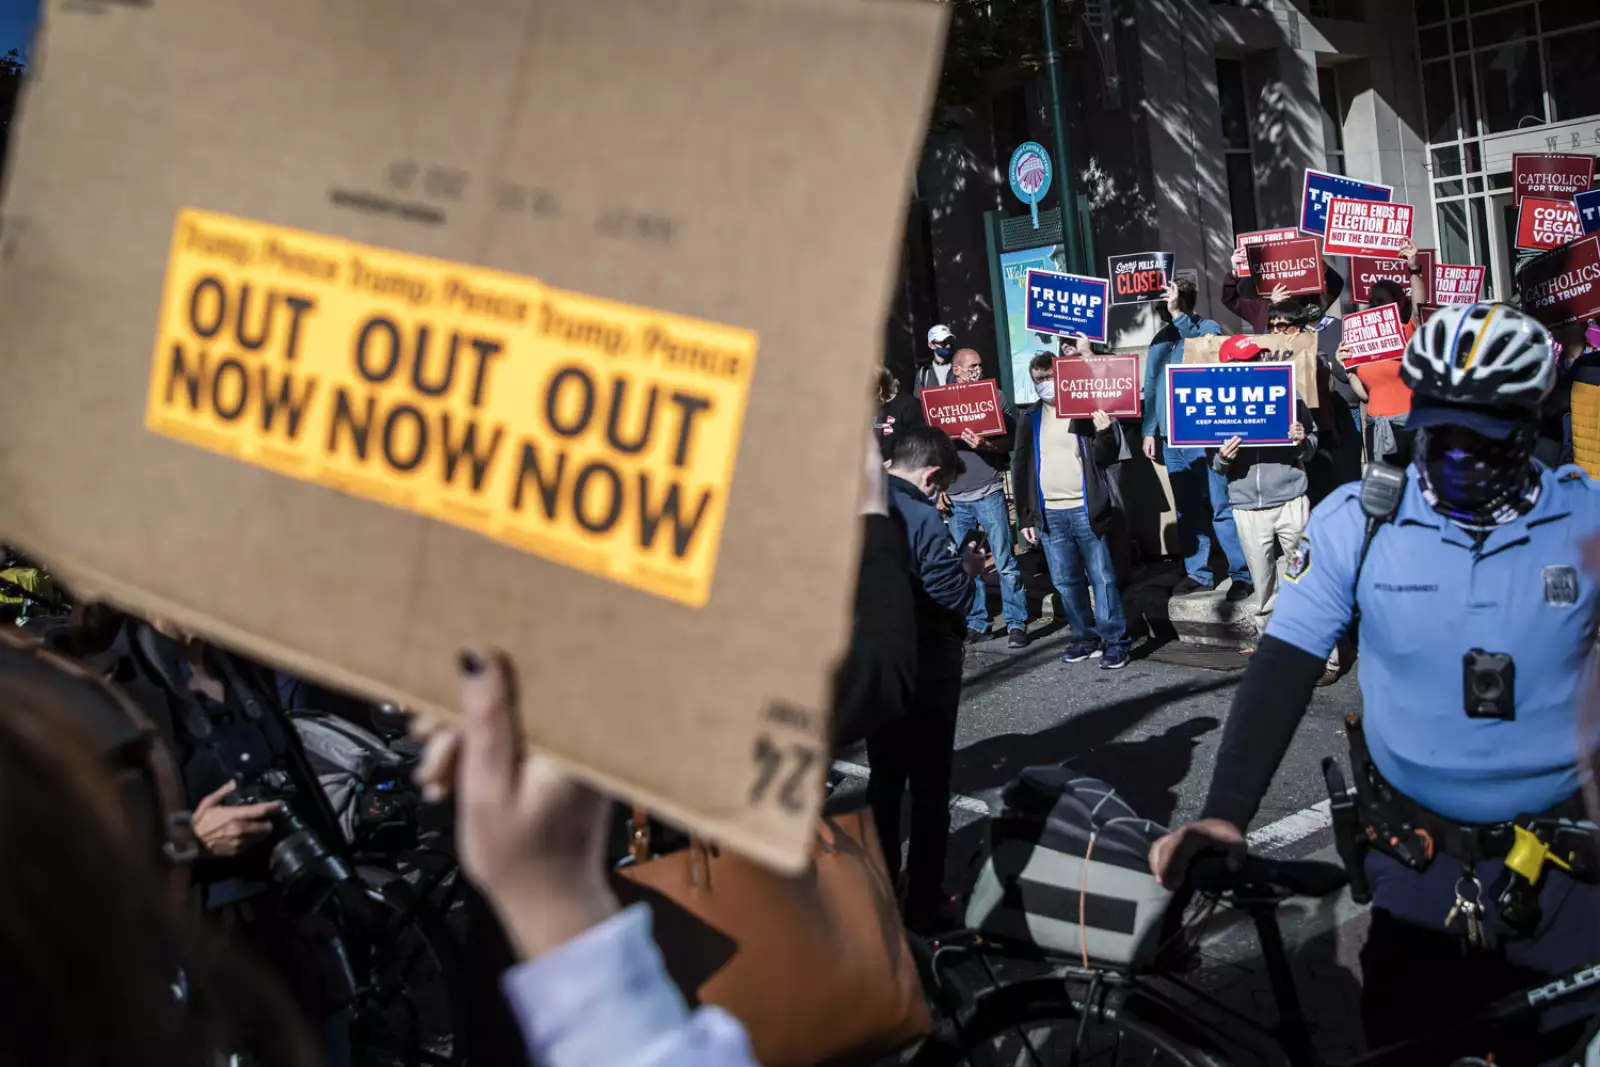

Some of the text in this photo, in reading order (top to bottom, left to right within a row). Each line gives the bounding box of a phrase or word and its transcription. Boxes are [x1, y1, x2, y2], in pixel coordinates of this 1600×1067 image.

[1518, 173, 1588, 187] CATHOLICS
[1548, 185, 1578, 193] TRUMP
[1333, 200, 1368, 216] VOTING
[1370, 204, 1395, 219] ENDS
[1397, 207, 1410, 220] ON
[1534, 207, 1578, 223] COUN
[1331, 213, 1409, 235] ELECTION DAY
[1534, 219, 1583, 234] LEGAL
[1331, 231, 1346, 241] NOT
[1348, 233, 1362, 243] THE
[1363, 235, 1379, 245] DAY
[1138, 260, 1155, 270] POLLS
[1253, 257, 1316, 274] CATHOLICS
[1375, 260, 1405, 270] TEXT
[1444, 267, 1467, 280] ENDS
[1469, 269, 1480, 280] ON
[1117, 270, 1168, 295] CLOSED
[1277, 270, 1307, 279] TRUMP
[1360, 273, 1410, 284] CATHOL
[1525, 262, 1600, 301] CATHOLICS
[1459, 280, 1479, 293] DAY
[1031, 286, 1102, 308] TRUMP
[1438, 293, 1451, 303] DAY
[1535, 283, 1592, 309] FOR TRUMP
[1036, 300, 1095, 318] PENCE
[1362, 312, 1382, 327] ENDS
[1382, 308, 1395, 321] ON
[190, 277, 314, 360] OUT
[1378, 320, 1397, 337] DAY
[1355, 344, 1367, 353] THE
[357, 317, 503, 407] OUT
[166, 343, 316, 440] NOW
[1060, 377, 1133, 391] CATHOLICS
[1071, 390, 1123, 399] FOR TRUMP
[1174, 385, 1287, 404] TRUMP
[546, 367, 711, 467] OUT
[929, 400, 995, 418] CATHOLICS
[1185, 404, 1277, 416] PENCE
[940, 413, 987, 425] FOR TRUMP
[326, 388, 503, 492] NOW
[511, 443, 712, 558] NOW
